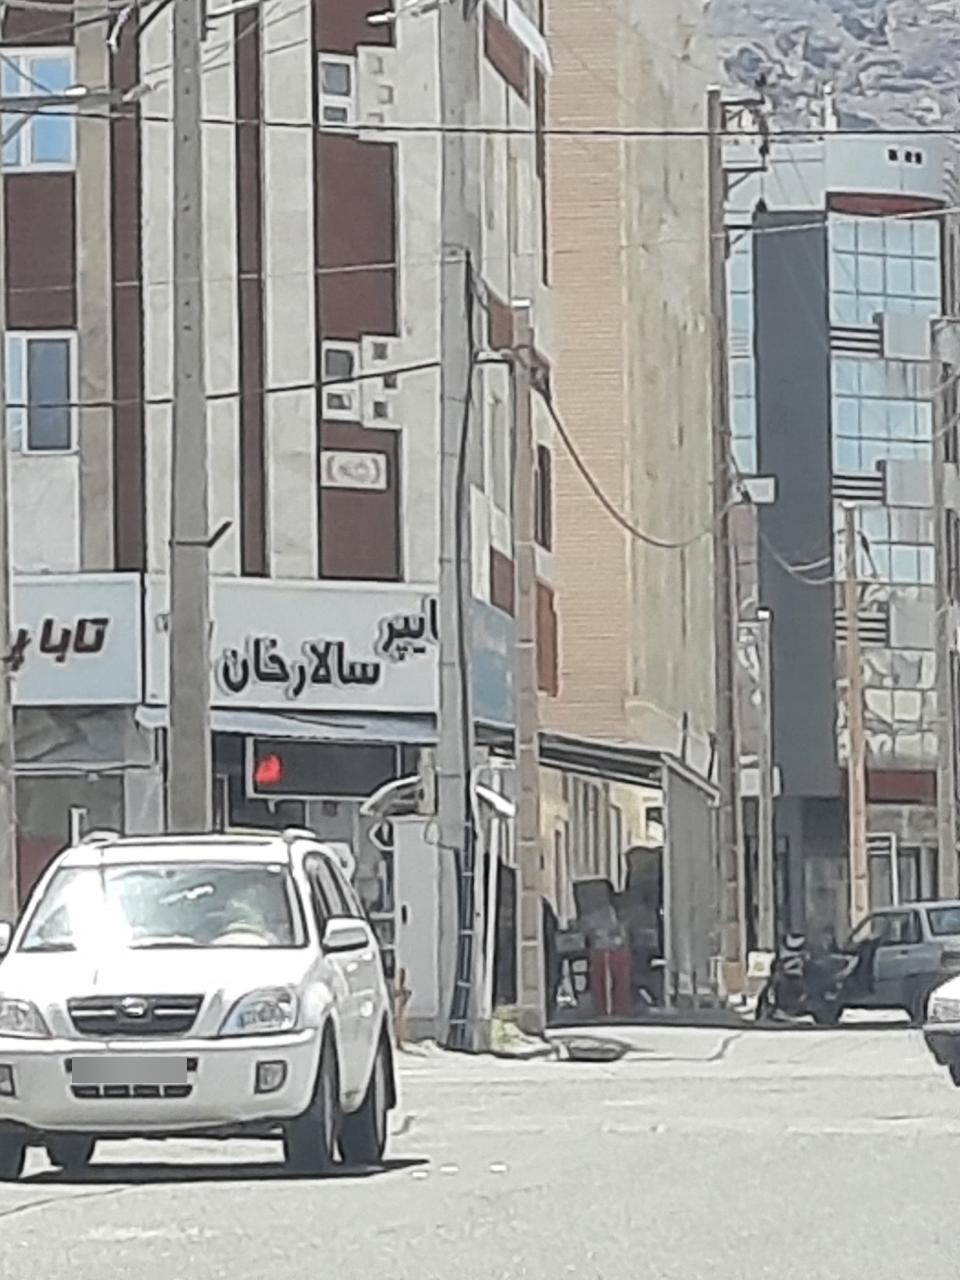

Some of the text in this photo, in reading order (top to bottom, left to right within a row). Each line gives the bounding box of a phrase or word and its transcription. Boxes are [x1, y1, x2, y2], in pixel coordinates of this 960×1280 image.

[40, 617, 110, 663] تابا
[381, 598, 439, 661] ایپر
[221, 637, 382, 698] سالارخان
